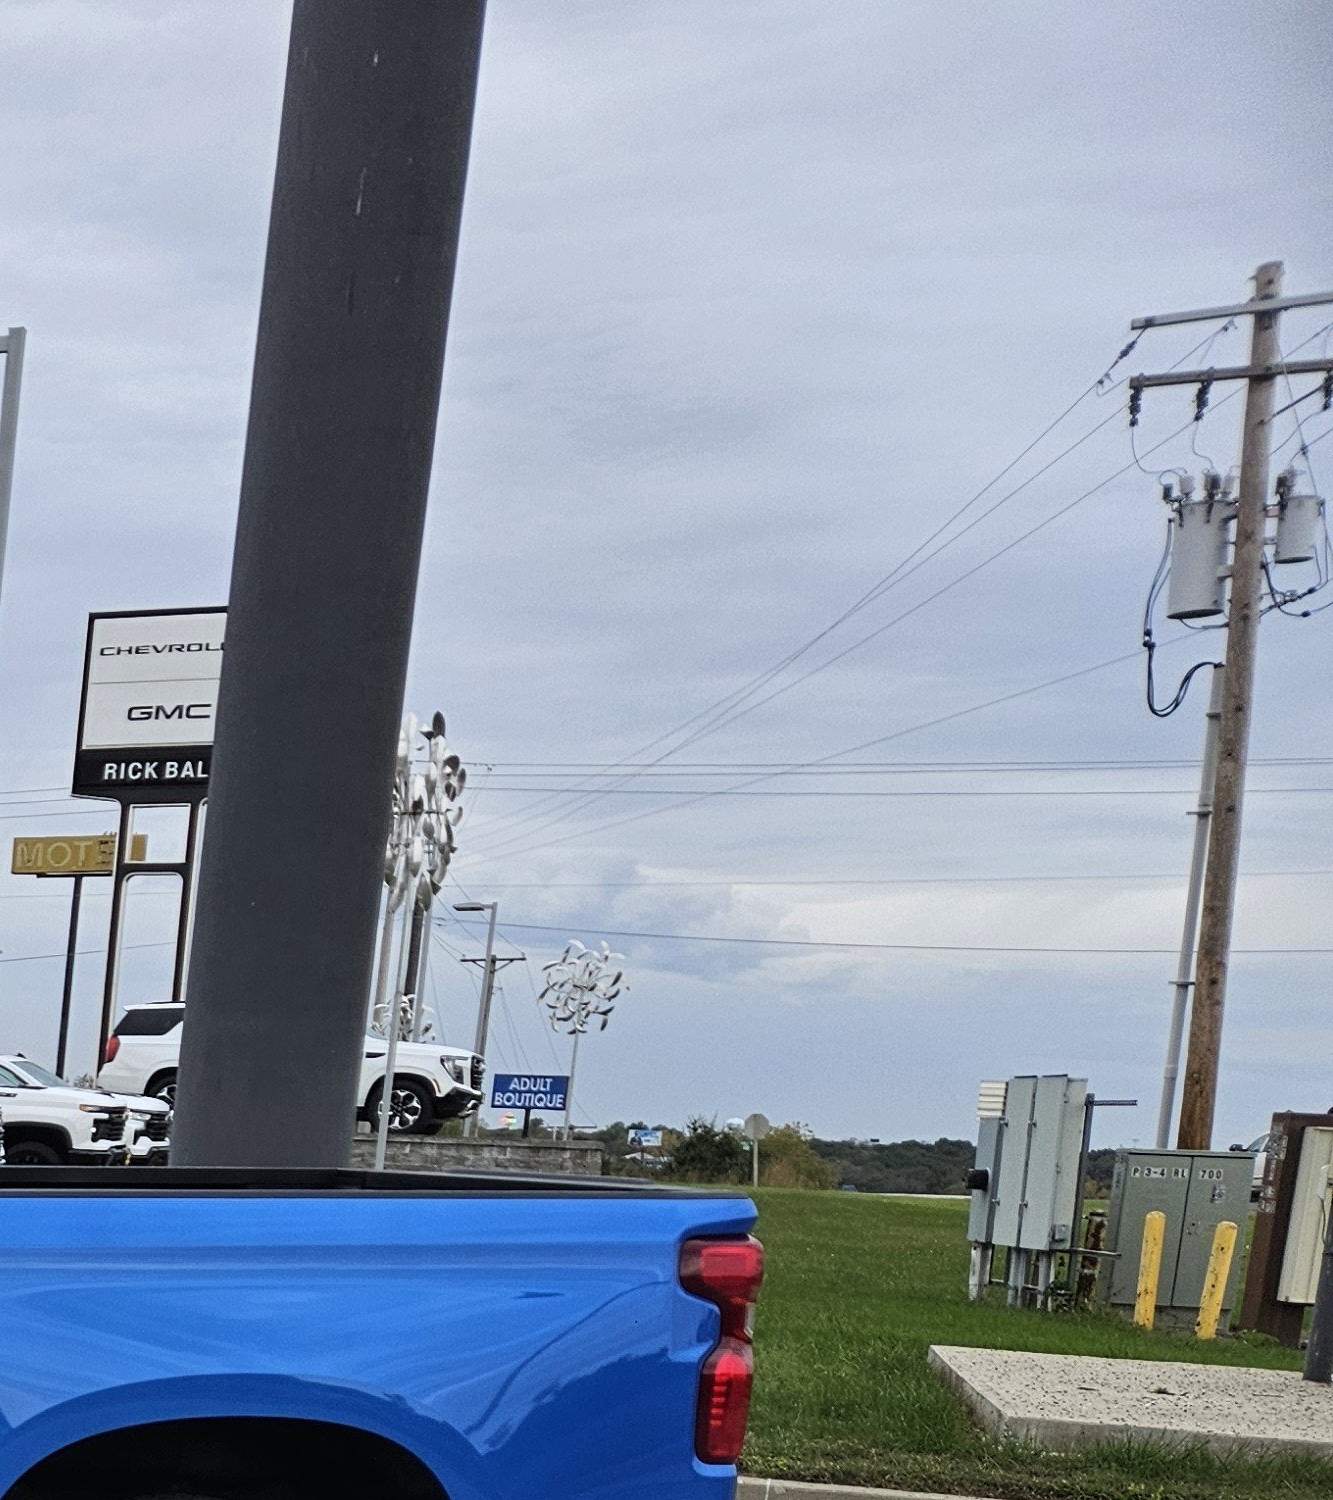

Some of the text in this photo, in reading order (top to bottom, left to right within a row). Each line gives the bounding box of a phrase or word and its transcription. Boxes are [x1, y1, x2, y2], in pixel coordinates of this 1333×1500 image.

[99, 642, 225, 657] CHEVROL
[127, 703, 212, 721] GMC
[103, 761, 209, 780] RICK BAL
[16, 839, 116, 868] MOTE
[509, 1077, 553, 1092] ADULT
[494, 1091, 565, 1108] BOUTIQUE
[1145, 1167, 1166, 1178] 3-4
[1200, 1169, 1223, 1179] 700
